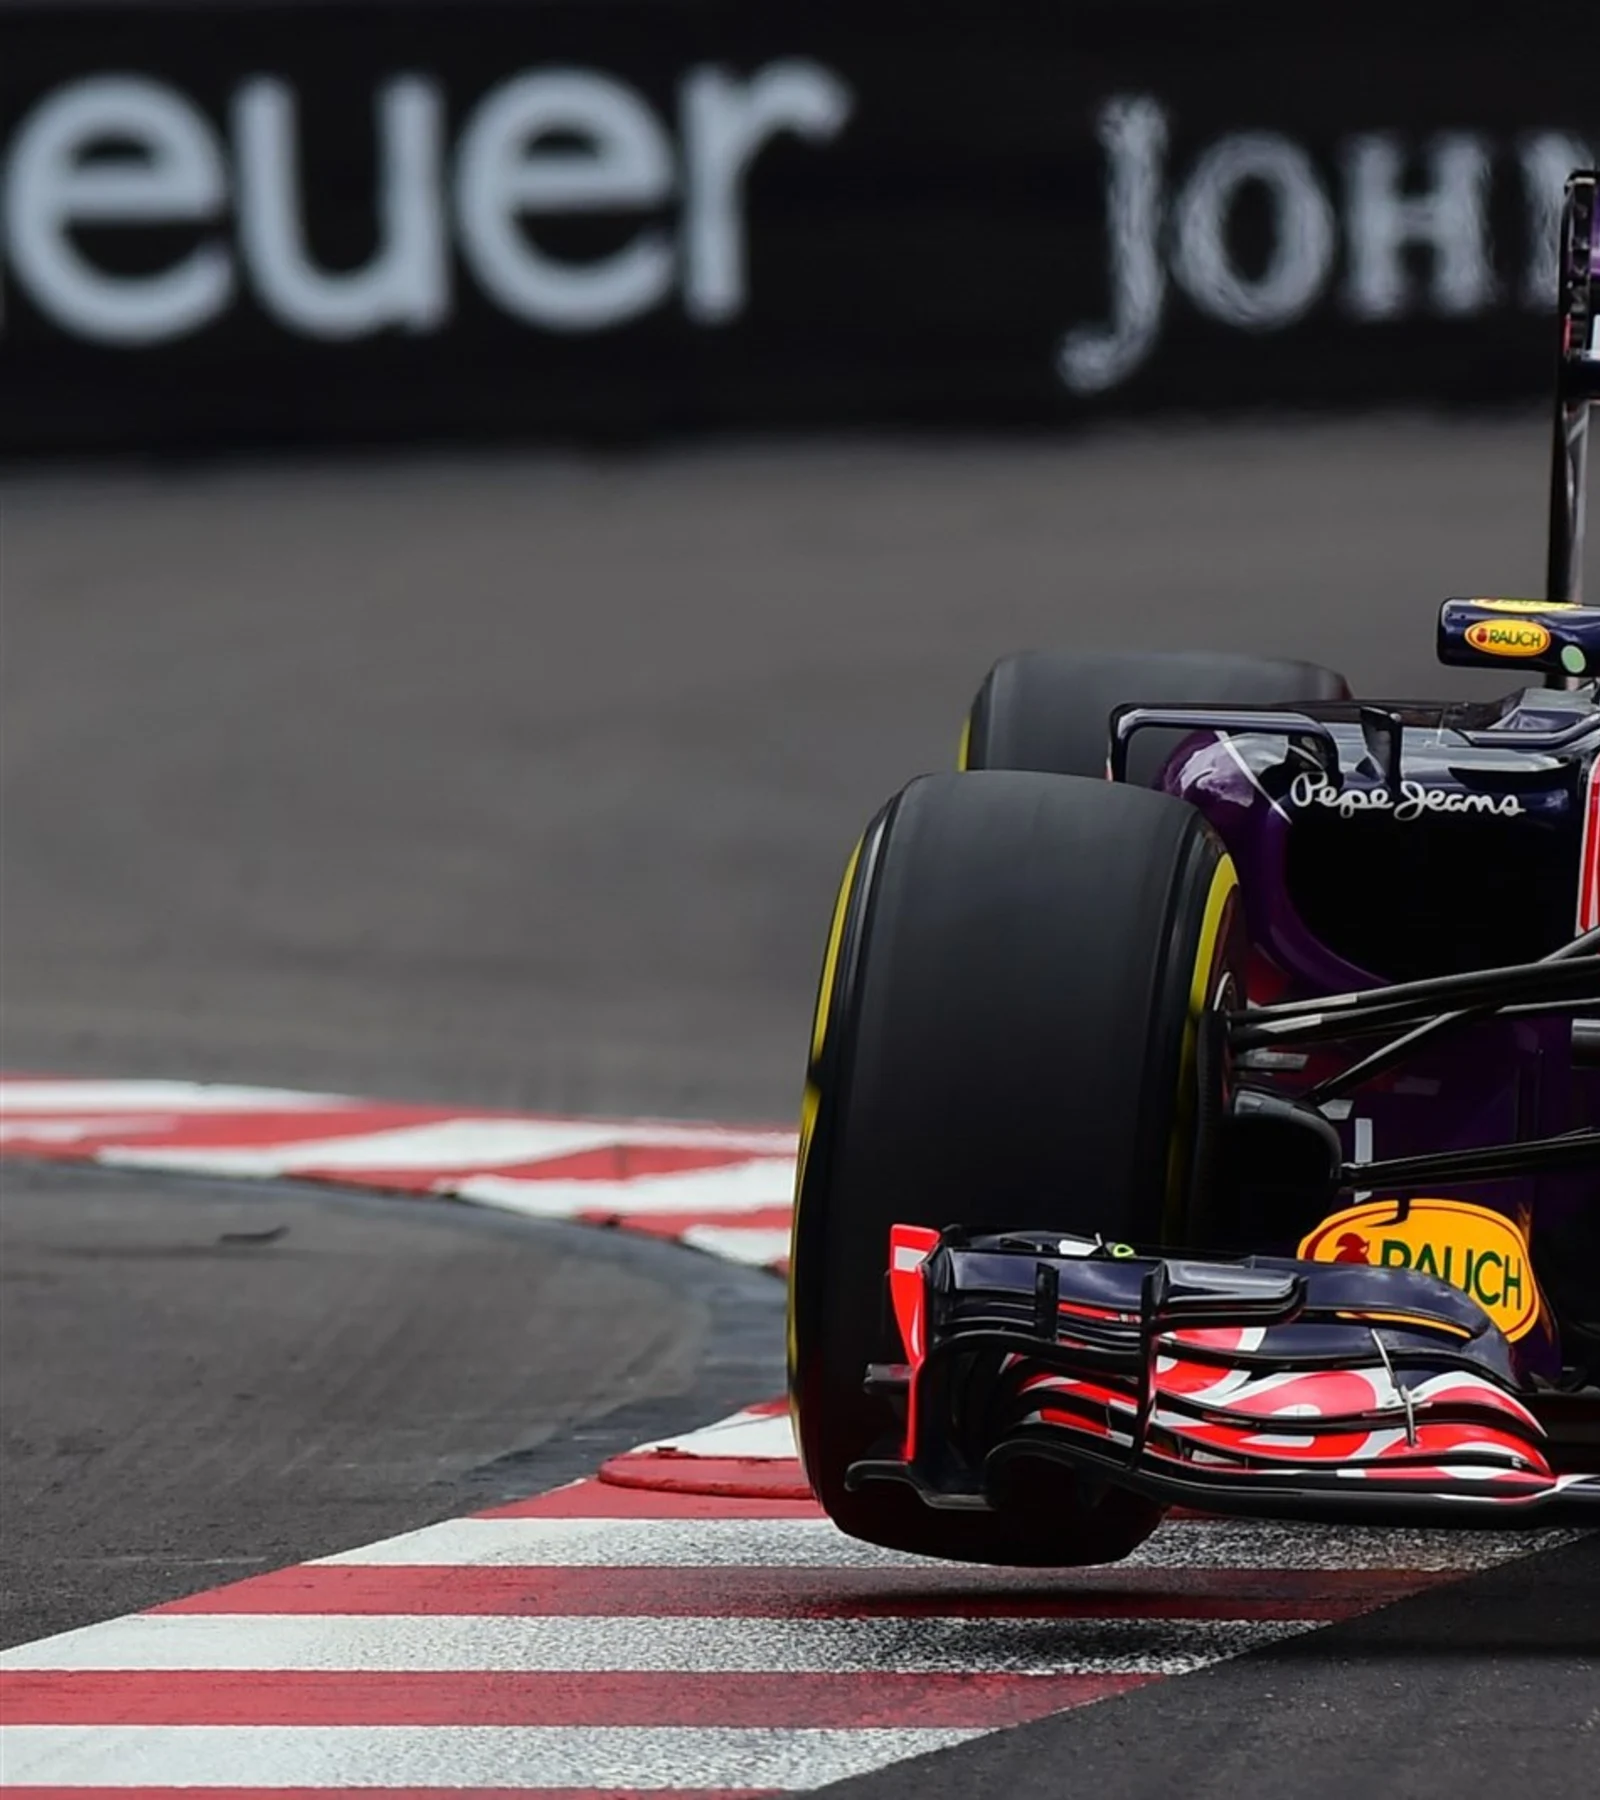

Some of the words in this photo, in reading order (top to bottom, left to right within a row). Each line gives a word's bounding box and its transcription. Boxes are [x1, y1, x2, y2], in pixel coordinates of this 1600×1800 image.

[1489, 628, 1541, 648] RAUCH
[1290, 772, 1395, 818] Pepe
[1393, 781, 1526, 821] Jeans
